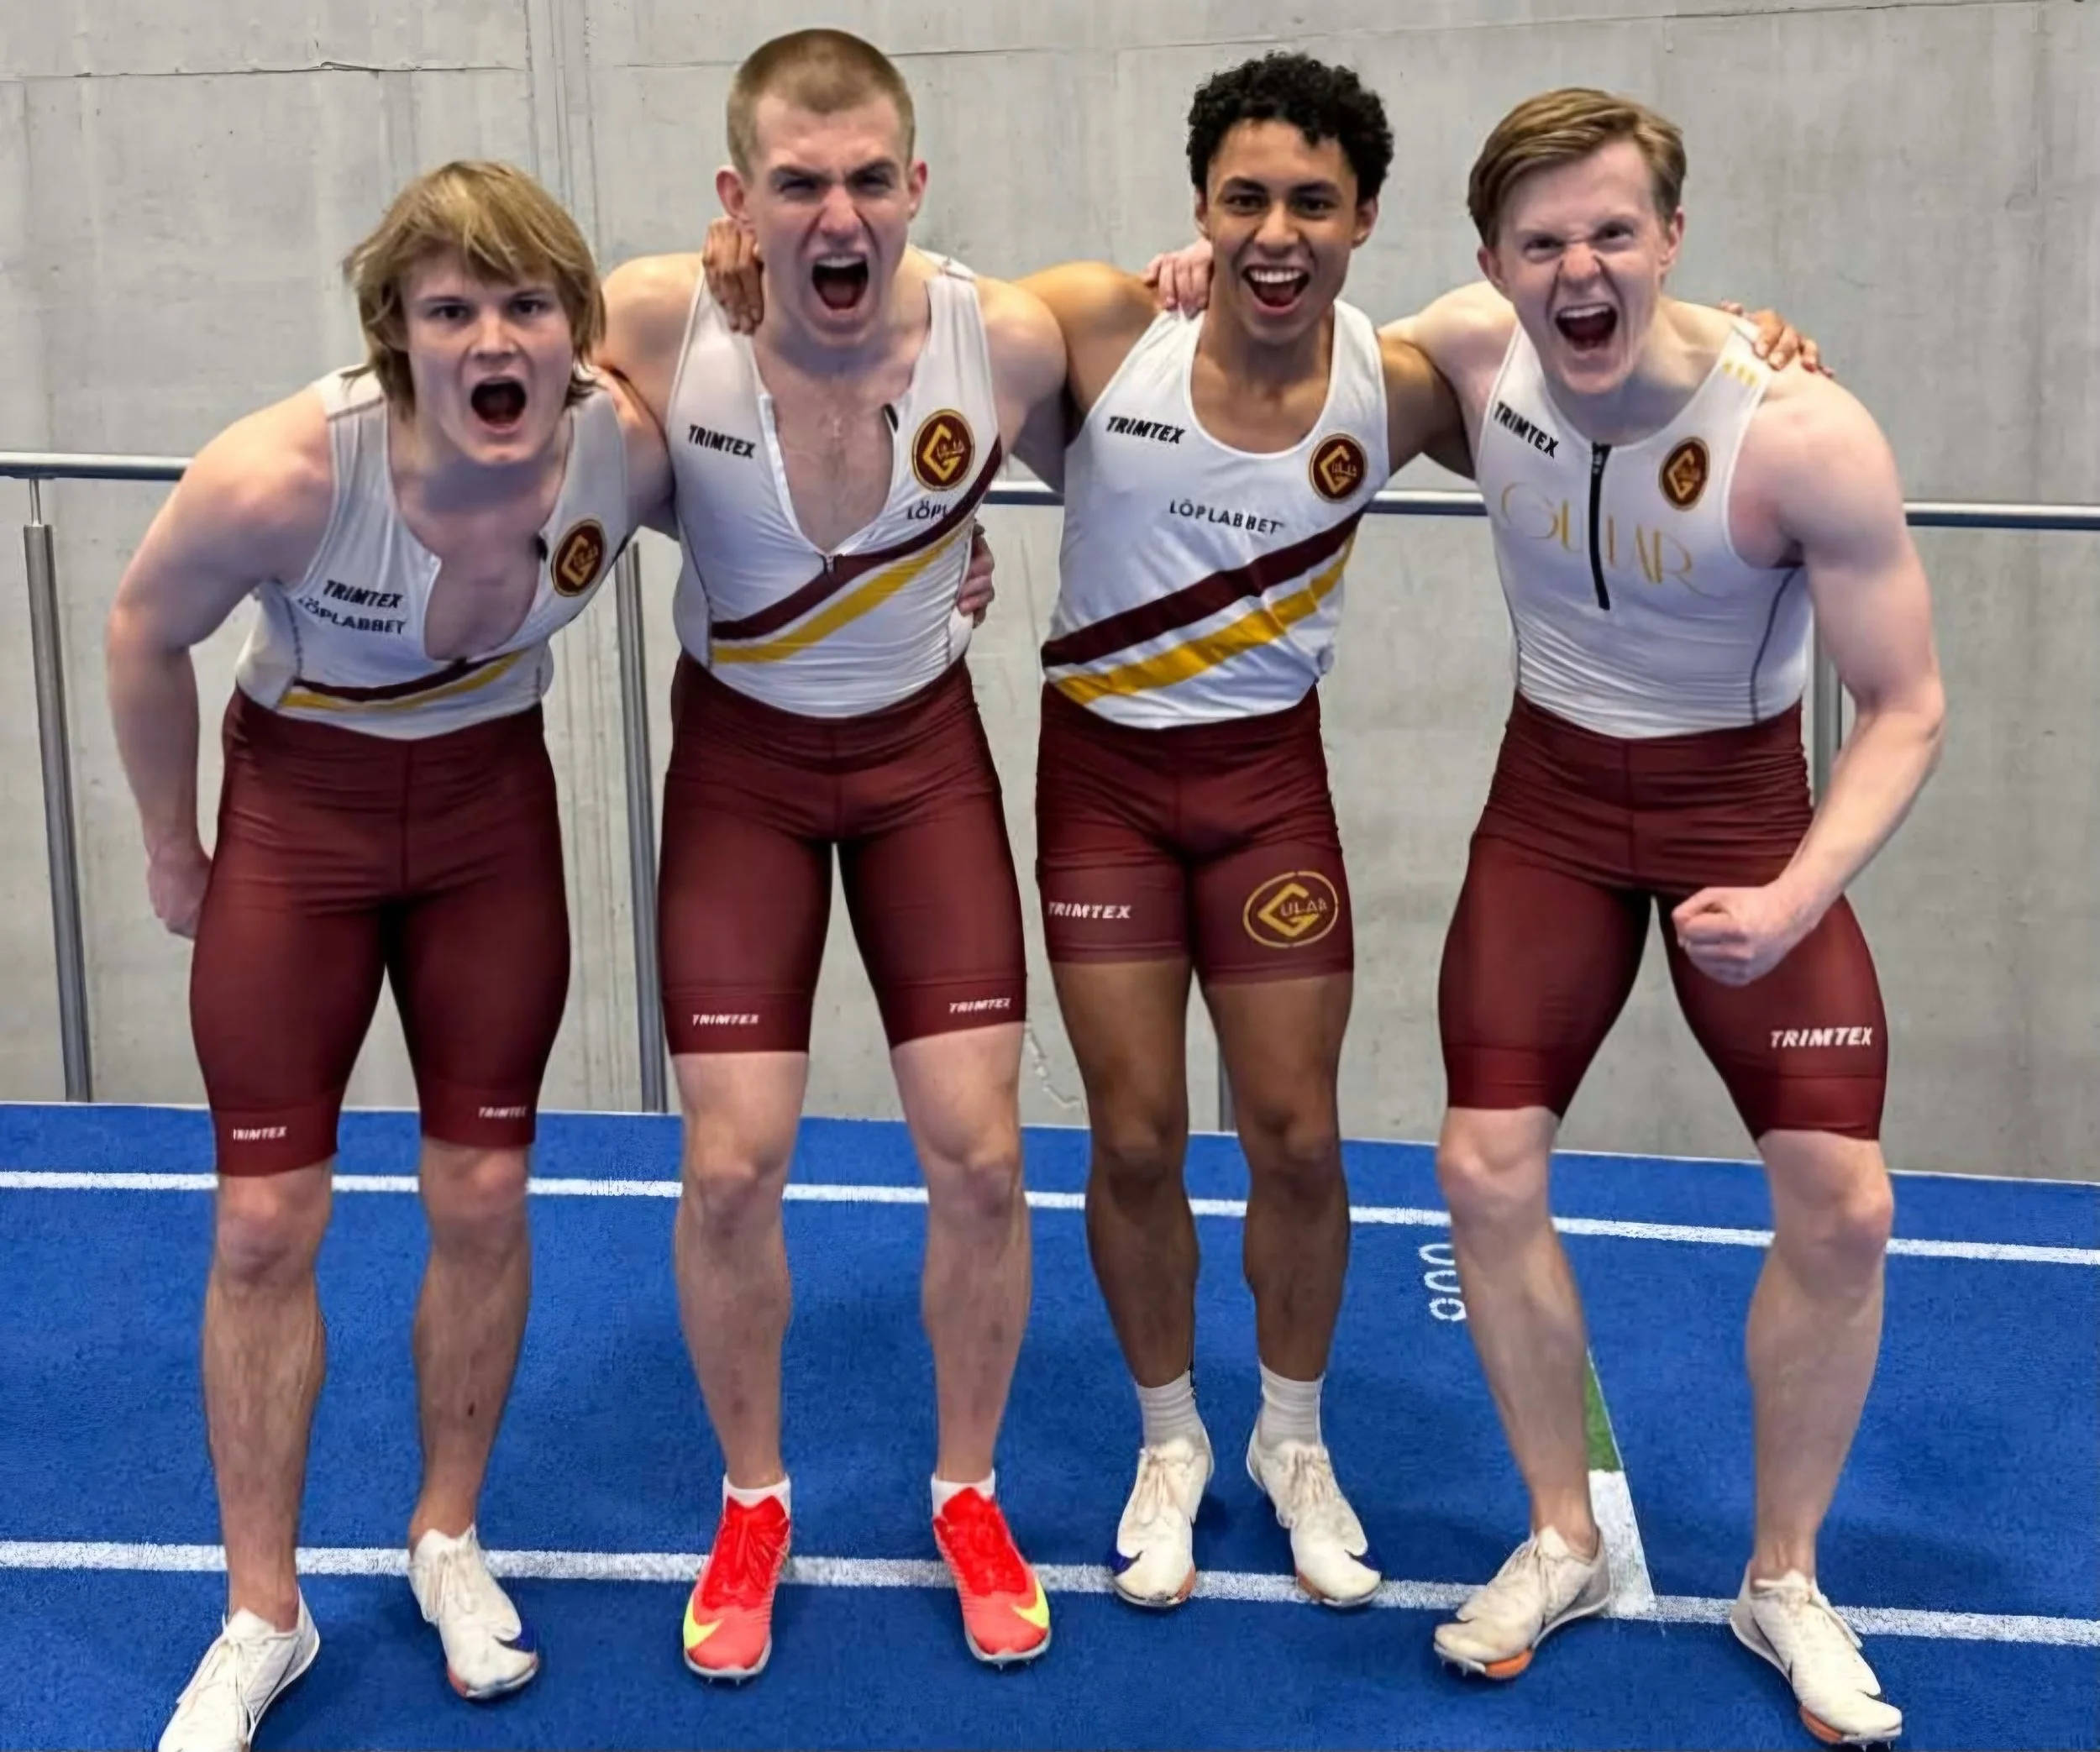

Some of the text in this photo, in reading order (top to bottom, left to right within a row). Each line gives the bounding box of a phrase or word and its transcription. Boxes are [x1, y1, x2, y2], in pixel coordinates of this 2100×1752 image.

[688, 424, 756, 459] TRIMTEX
[1106, 417, 1185, 444] TRIMTEX
[1494, 401, 1559, 459] TRIMTEX
[1169, 500, 1285, 535] LÖPLABBET
[323, 580, 403, 608] TRIMTEX
[1048, 901, 1131, 920] TRIMTEX
[1771, 1026, 1872, 1048] TRIMTEX
